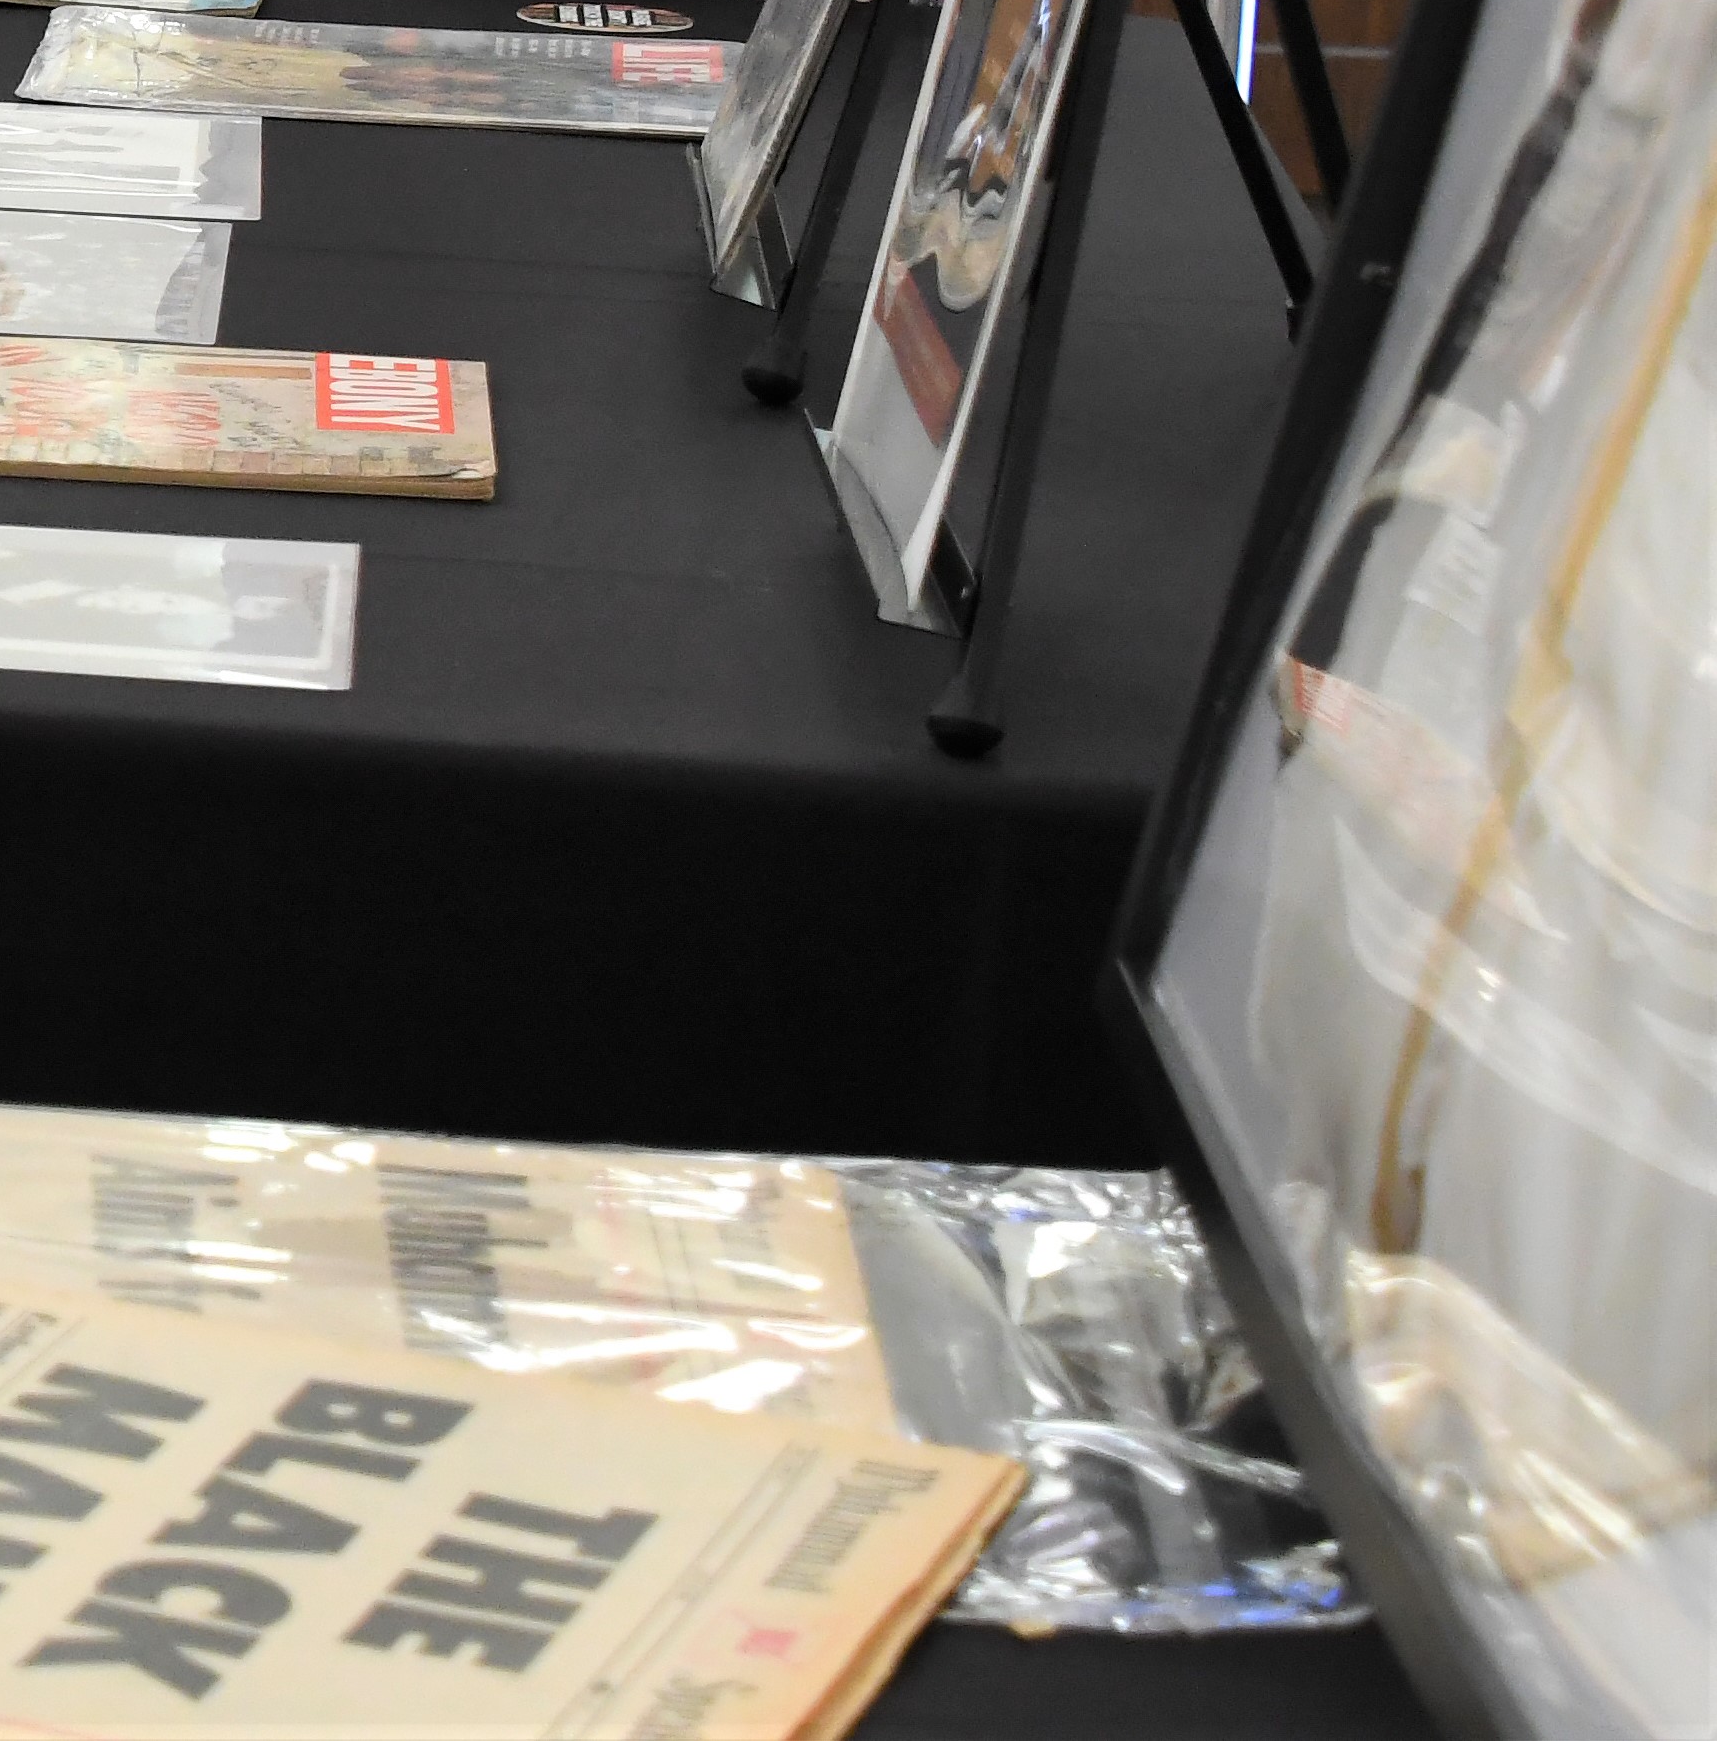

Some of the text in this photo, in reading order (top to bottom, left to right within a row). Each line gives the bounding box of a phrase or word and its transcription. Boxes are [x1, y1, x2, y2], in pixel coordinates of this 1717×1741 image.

[330, 354, 440, 433] EBONY
[23, 1378, 471, 1702] BLACK
[338, 1491, 658, 1683] THE
